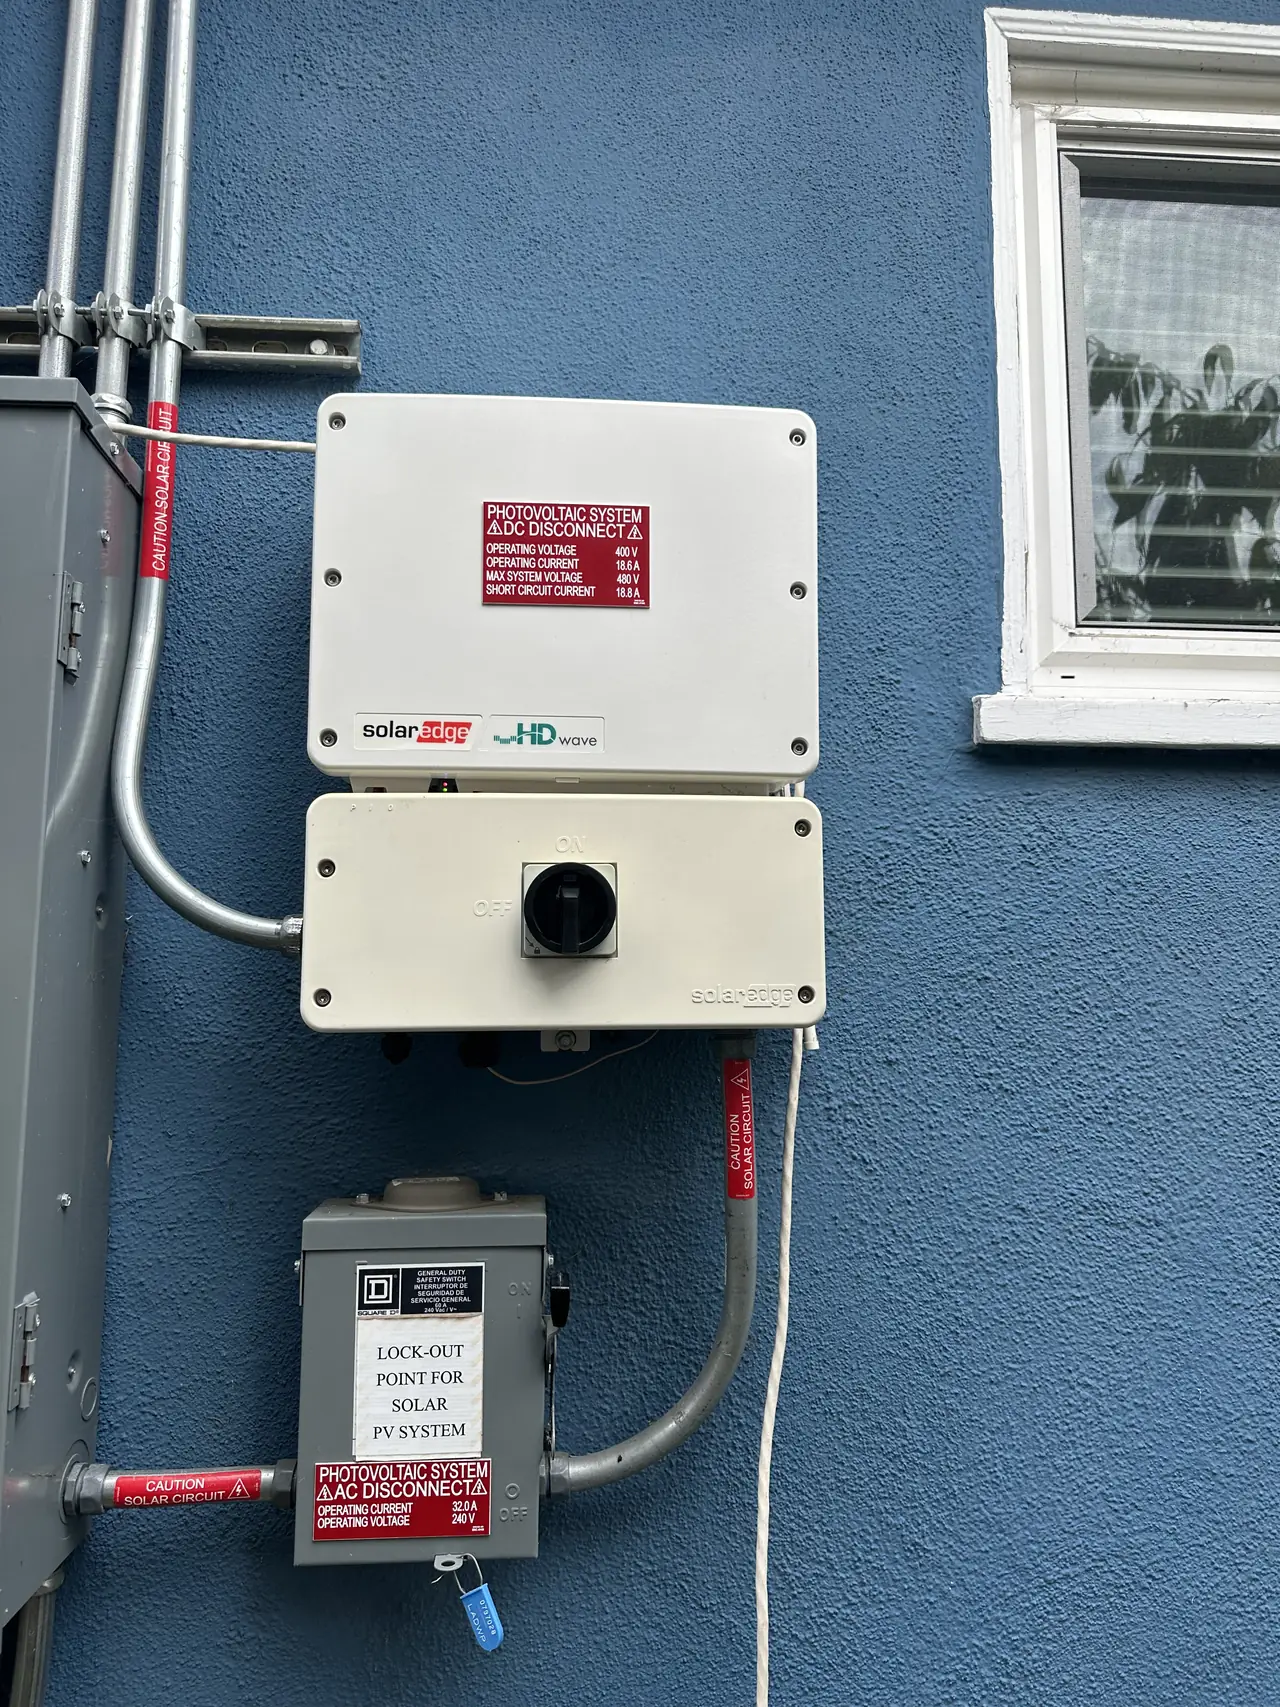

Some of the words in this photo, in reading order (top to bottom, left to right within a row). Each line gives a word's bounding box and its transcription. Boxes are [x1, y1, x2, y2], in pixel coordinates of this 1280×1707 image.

[157, 407, 172, 461] CIRUIT
[155, 465, 170, 509] SOLAR
[487, 504, 586, 521] PHOTOVOLTAIC
[589, 508, 642, 523] SYSTEM
[503, 520, 525, 536] DC
[529, 521, 626, 538] DISCONNECT
[152, 511, 168, 571] CAUTION
[486, 543, 536, 555] OPERATING
[538, 544, 577, 556] VOLTAGE
[615, 546, 630, 557] 400
[631, 547, 638, 557] V
[486, 557, 536, 569] OPERATING
[537, 558, 579, 569] CURRENT
[616, 560, 633, 571] 18.6
[633, 561, 640, 571] A
[486, 571, 505, 582] MAX
[506, 571, 542, 583] SYSTEM
[544, 572, 583, 583] VOLTAGE
[616, 574, 632, 585] 480
[632, 574, 640, 585] V
[486, 584, 516, 596] SHORT
[517, 584, 553, 596] CIRCUIT
[554, 586, 596, 597] CURRENT
[616, 587, 633, 598] 18.8
[633, 588, 640, 598] A
[516, 722, 557, 746] HD
[558, 735, 597, 746] wave
[555, 835, 586, 853] ON
[472, 900, 513, 917] OFF
[741, 1093, 752, 1144] CIRCUIT
[730, 1114, 740, 1170] CAUTION
[743, 1146, 753, 1189] SOLAR
[508, 1281, 531, 1296] ON
[377, 1344, 464, 1360] LOCK-OUT
[376, 1371, 427, 1387] POINT
[431, 1370, 464, 1384] FOR
[392, 1397, 448, 1412] SOLAR
[373, 1425, 394, 1440] PV
[399, 1423, 466, 1439] SYSTEM
[319, 1463, 427, 1483] PHOTOVOLTAIC
[430, 1462, 488, 1480] SYSTEM
[146, 1478, 205, 1492] CAUTION
[334, 1483, 358, 1500] AC
[363, 1480, 473, 1499] DISCONNECT
[124, 1494, 168, 1506] SOLAR
[172, 1491, 226, 1504] CIRCUIT
[318, 1503, 368, 1516] OPERATING
[370, 1502, 413, 1514] CURRENT
[452, 1501, 470, 1512] 32.0
[470, 1501, 478, 1512] A
[500, 1507, 528, 1522] OFF
[318, 1516, 368, 1529] OPERATING
[370, 1515, 410, 1527] VOLTAGE
[452, 1513, 468, 1524] 240
[468, 1513, 475, 1524] V
[467, 1603, 487, 1643] LADWP
